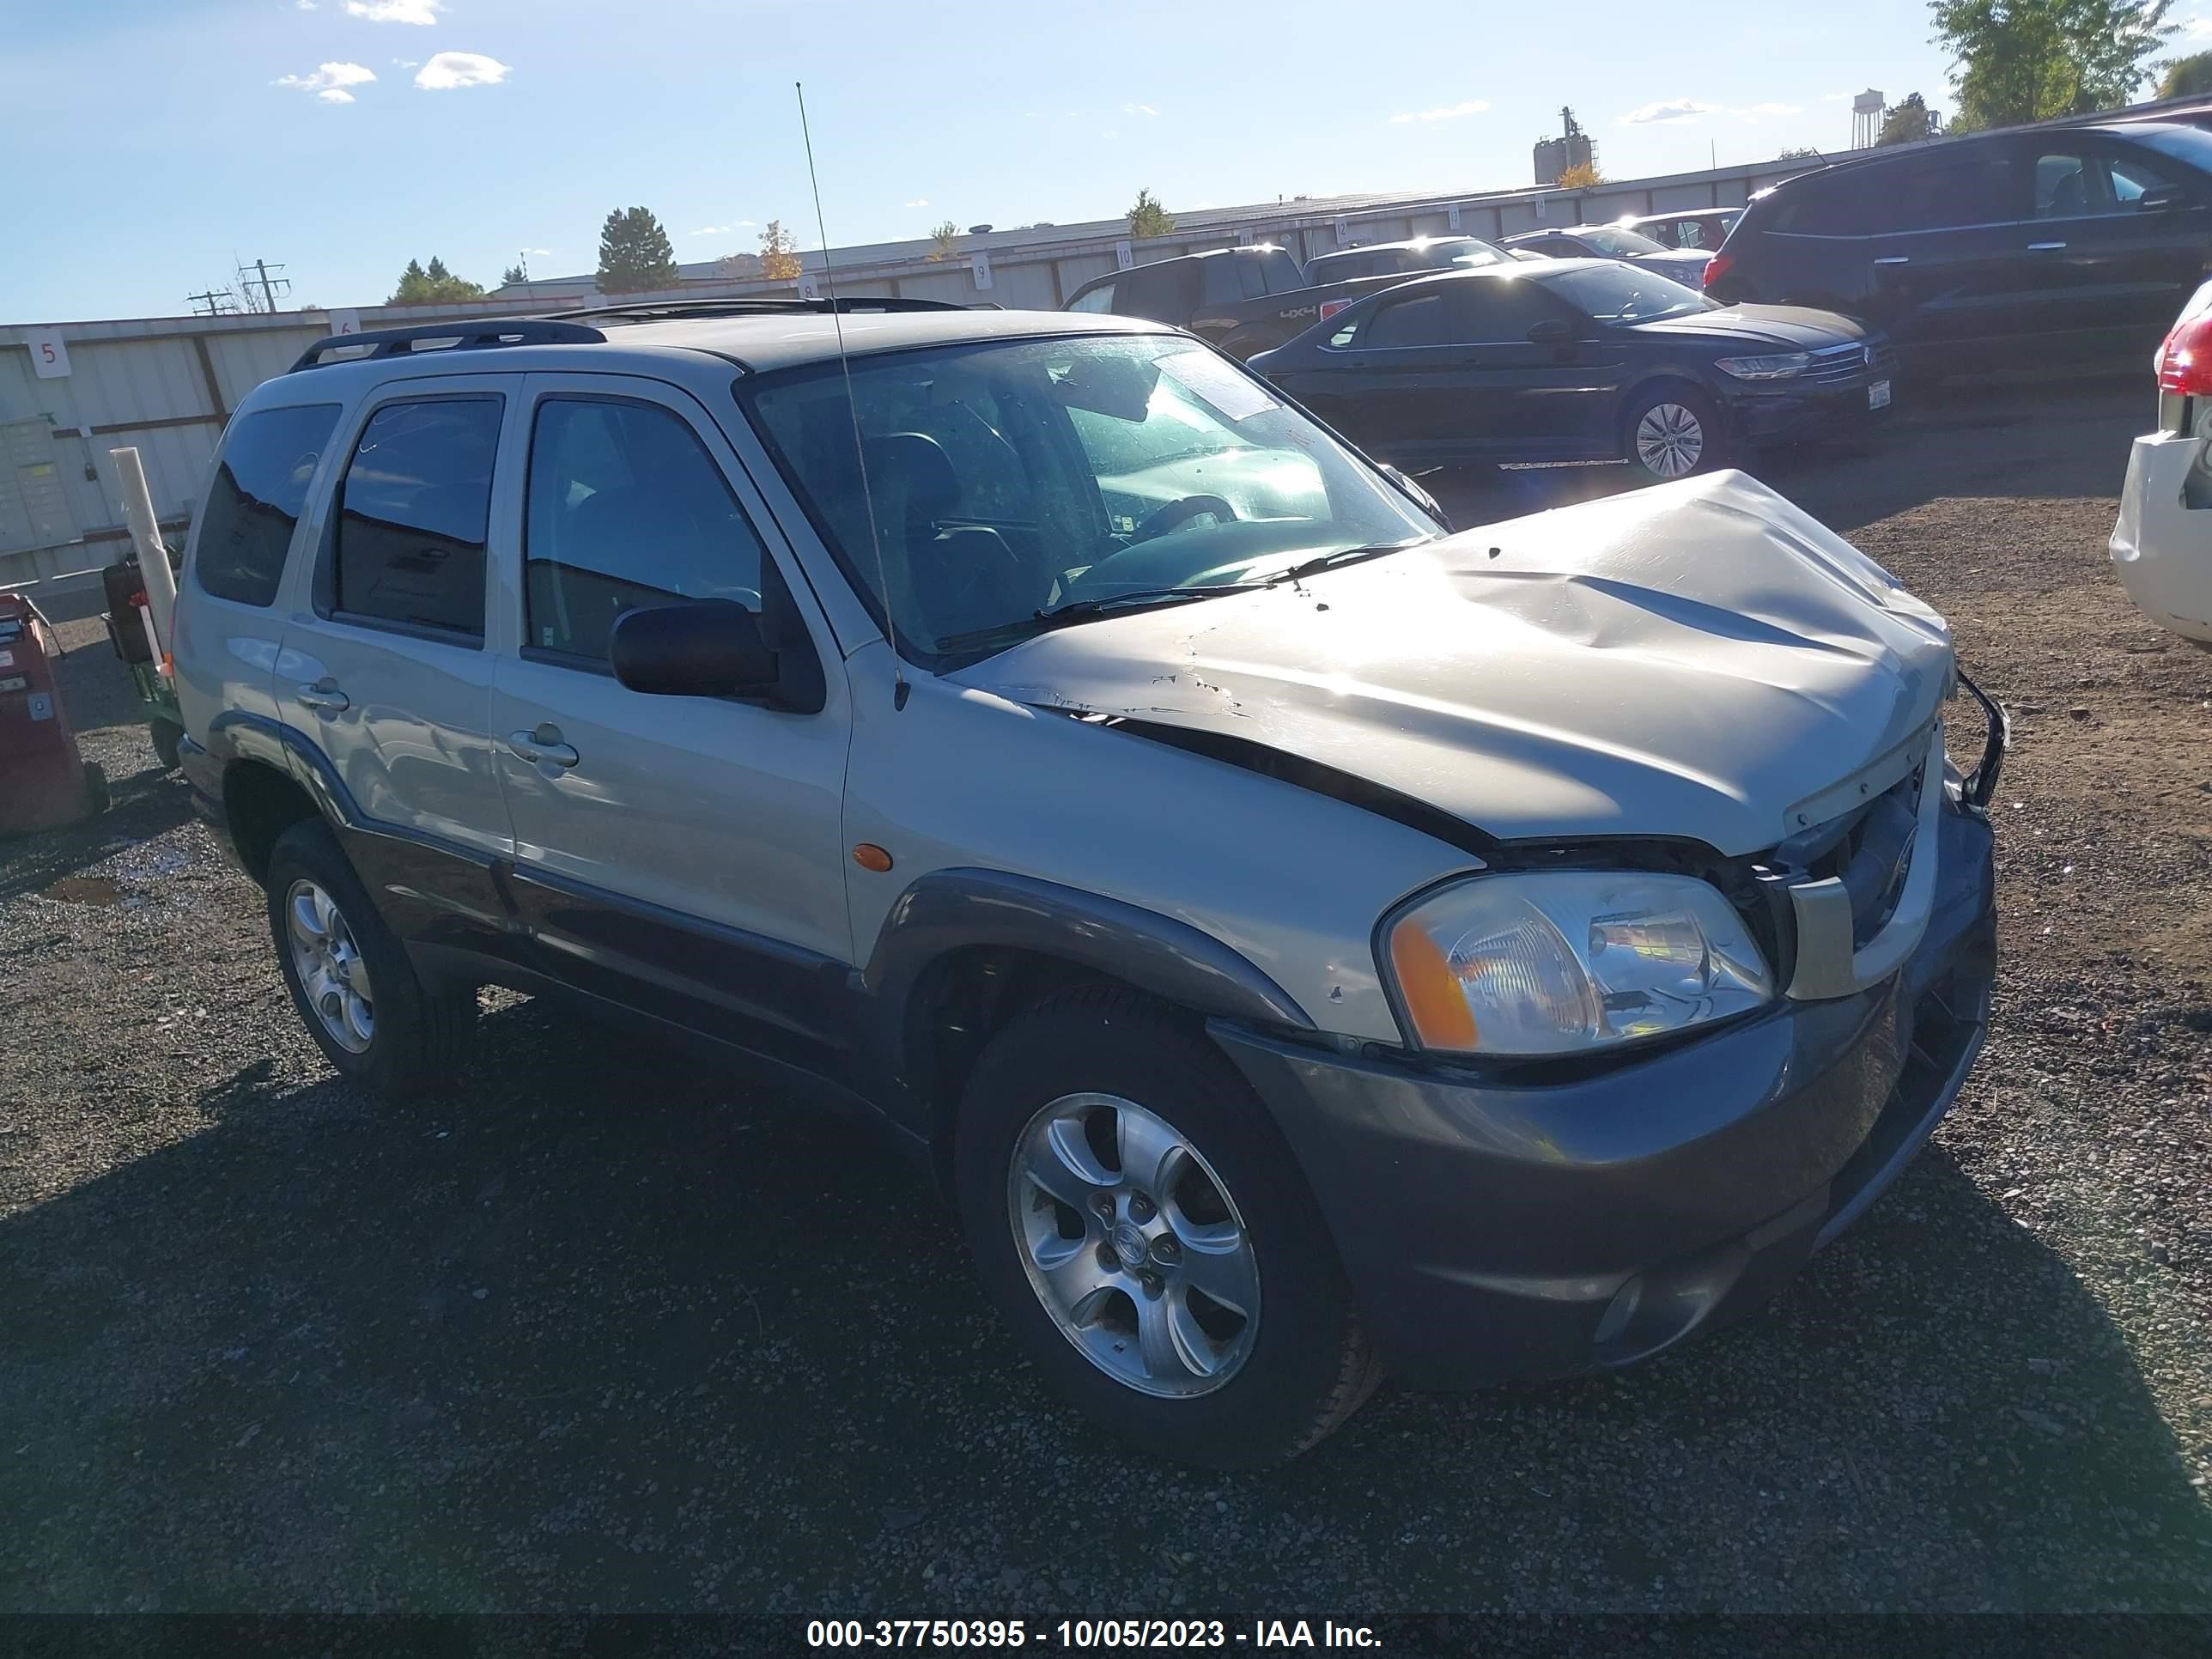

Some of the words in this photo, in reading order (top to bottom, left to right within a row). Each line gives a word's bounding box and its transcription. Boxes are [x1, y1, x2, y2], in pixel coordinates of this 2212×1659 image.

[1337, 223, 1346, 234] 12
[1119, 250, 1130, 263] 10
[978, 265, 985, 279] 9
[805, 285, 811, 298] 8
[40, 343, 56, 364] 5
